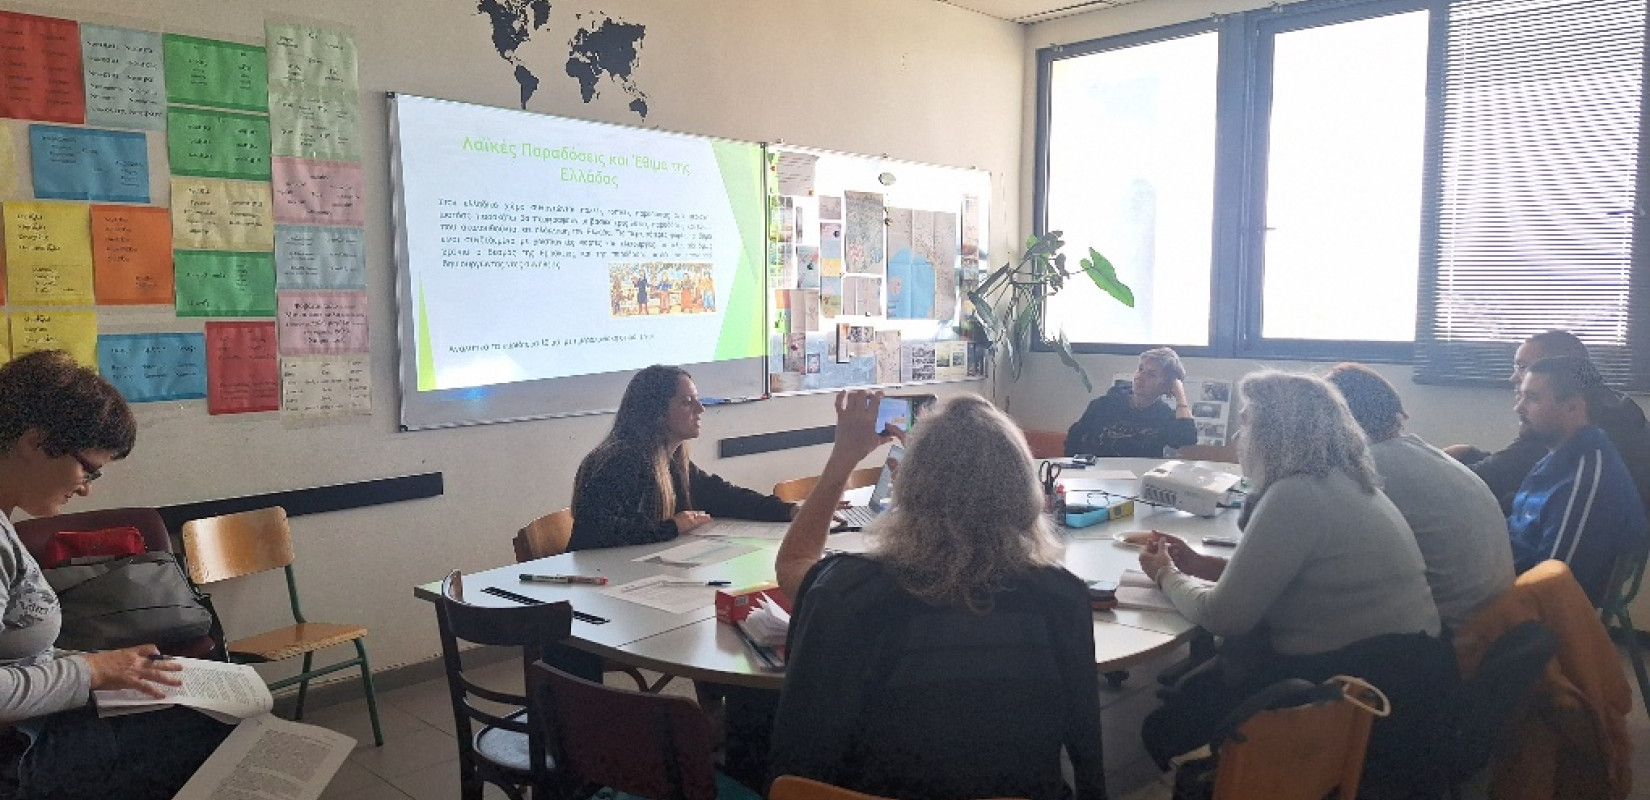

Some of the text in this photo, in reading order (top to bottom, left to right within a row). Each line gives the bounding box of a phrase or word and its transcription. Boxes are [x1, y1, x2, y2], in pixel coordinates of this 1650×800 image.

[462, 136, 691, 176] Λαϊκές Παραδόσεις και Έθιμα της
[560, 167, 619, 188] Ελλάδας
